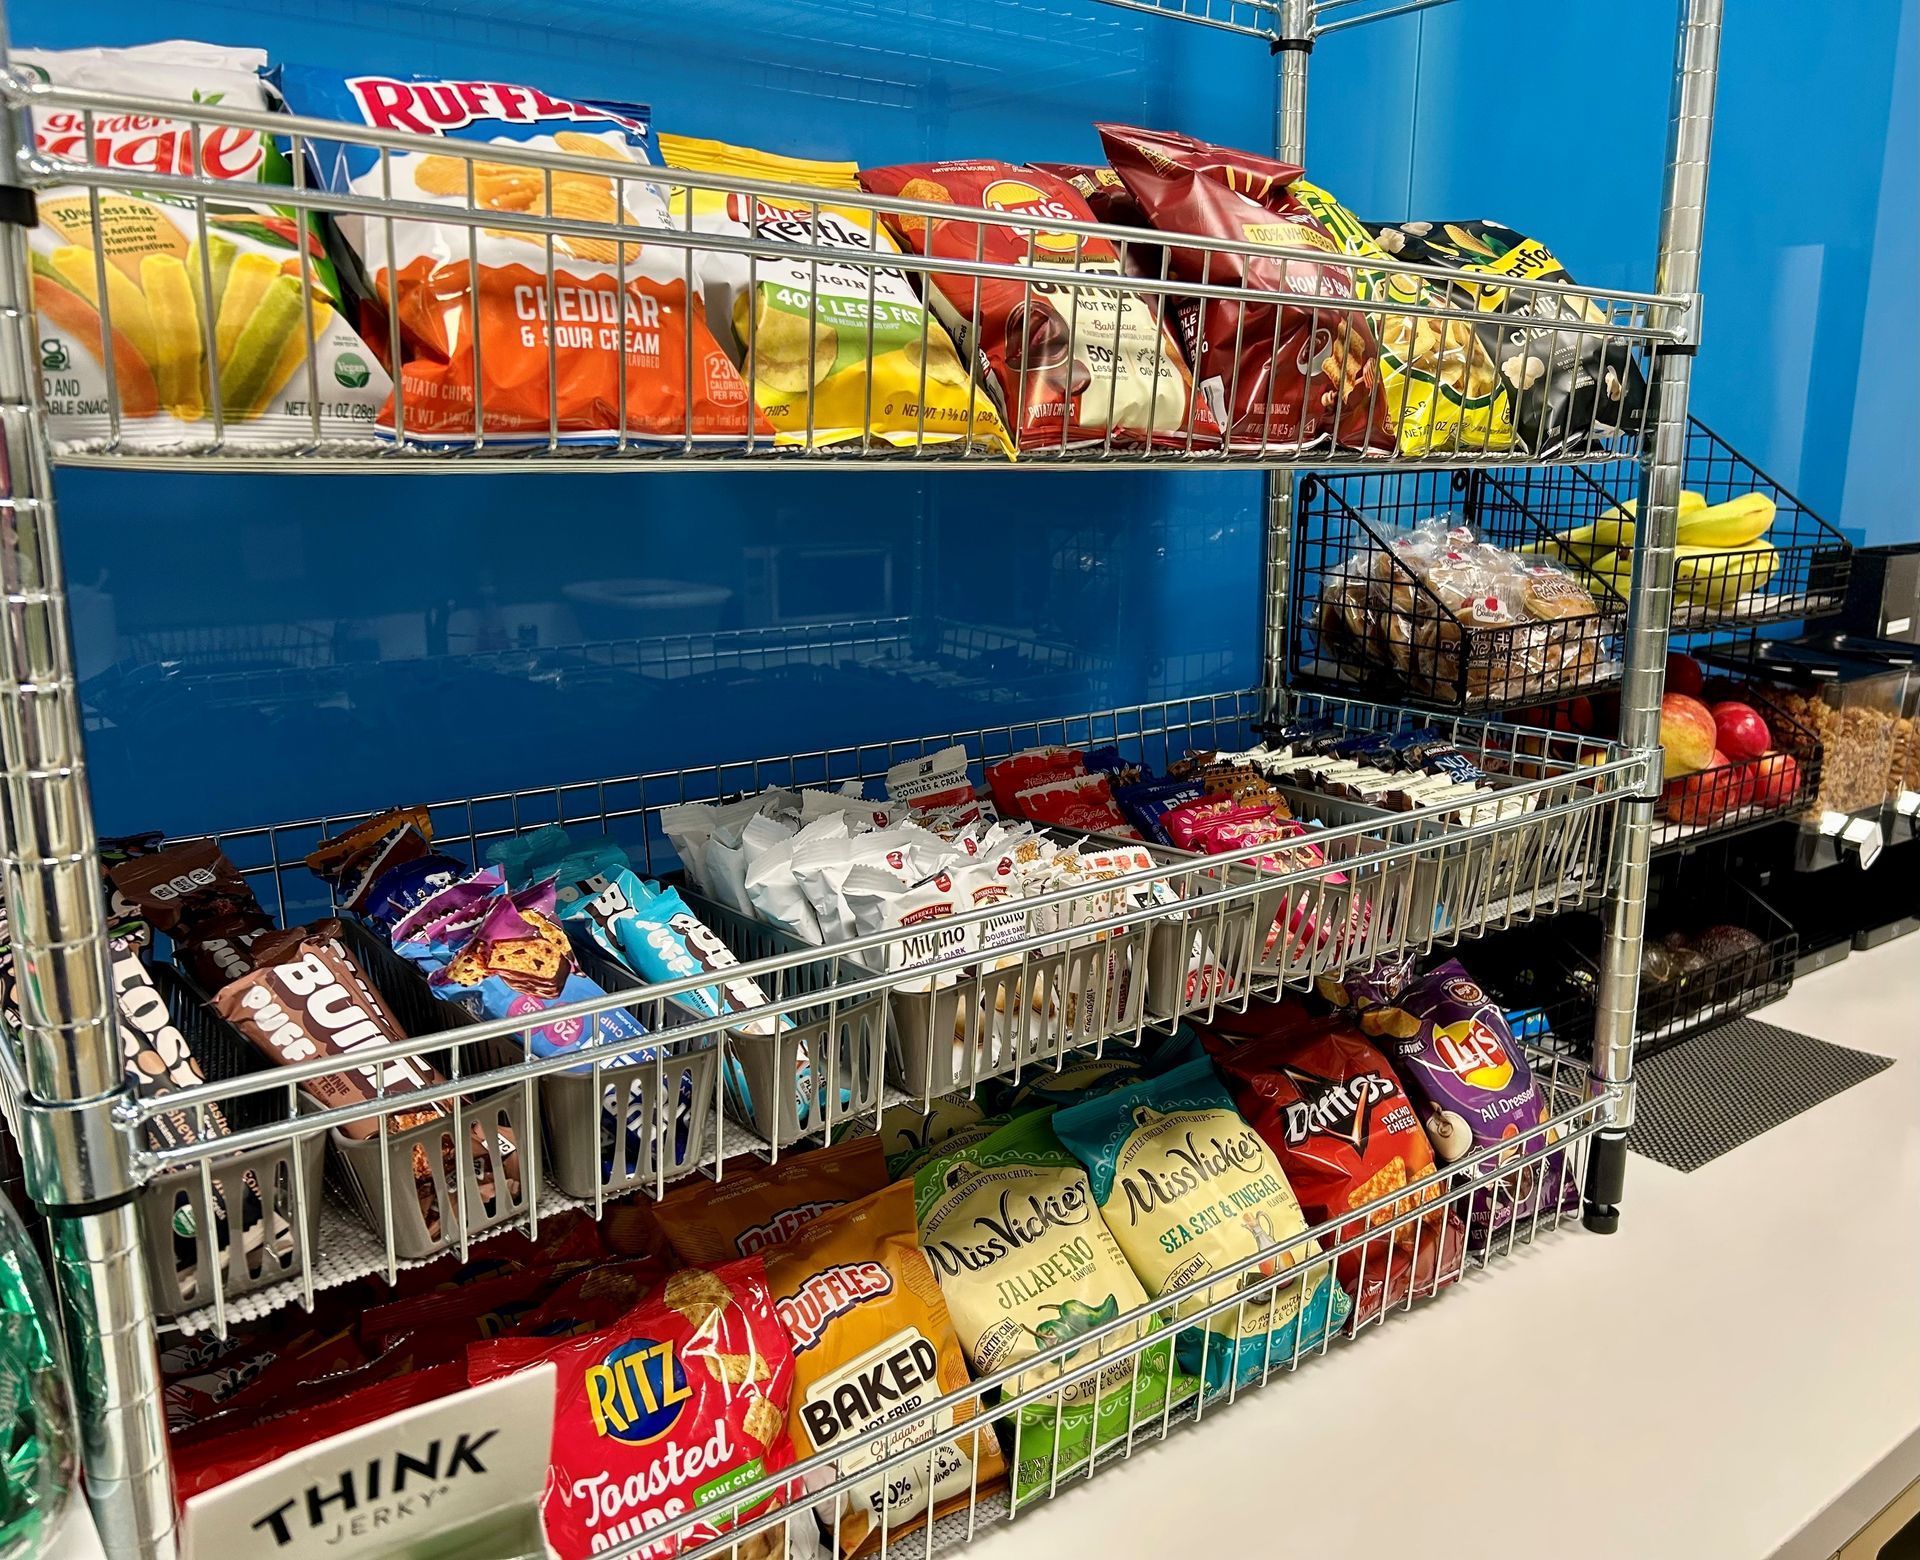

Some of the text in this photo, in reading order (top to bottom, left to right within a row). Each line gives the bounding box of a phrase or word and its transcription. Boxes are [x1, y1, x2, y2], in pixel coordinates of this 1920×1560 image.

[132, 205, 154, 217] Fat
[890, 306, 922, 326] FAT
[521, 326, 536, 347] &
[336, 363, 367, 373] Vegan
[55, 379, 80, 397] AND
[442, 381, 472, 402] CHIPS
[284, 402, 306, 416] NET
[336, 403, 351, 417] OZ
[1434, 754, 1473, 772] NUT
[896, 784, 932, 798] COOKIES
[941, 774, 966, 788] CREAM
[934, 903, 951, 914] FARM
[985, 928, 1012, 943] DOUBLE
[944, 946, 967, 960] DARK
[241, 985, 317, 1062] PUFF
[600, 1016, 624, 1038] CHIP
[1381, 1105, 1411, 1125] NACHO
[1480, 1087, 1536, 1123] All Dressed
[1187, 1113, 1212, 1123] CHIPS
[1386, 1115, 1417, 1135] CHEESE
[1121, 1129, 1267, 1228] Miss Vickie's
[928, 1169, 1034, 1233] KETTLE COOKED POTATO CHIPS
[1159, 1173, 1283, 1255] SEA SALT & VINEGAR
[923, 1178, 1092, 1286] Miss Vickie's
[996, 1235, 1095, 1310] JALAPEÑO
[976, 1320, 1017, 1369] NO ARTIFICIAL
[585, 1338, 692, 1437] RITZ
[802, 1338, 937, 1447] BAKED
[1107, 1376, 1115, 1387] &
[888, 1395, 923, 1418] FRIED
[573, 1418, 735, 1528] Toasted
[950, 1458, 962, 1473] Oil
[251, 1428, 501, 1549] THINK
[700, 1478, 733, 1504] sour
[326, 1488, 440, 1546] JERKY
